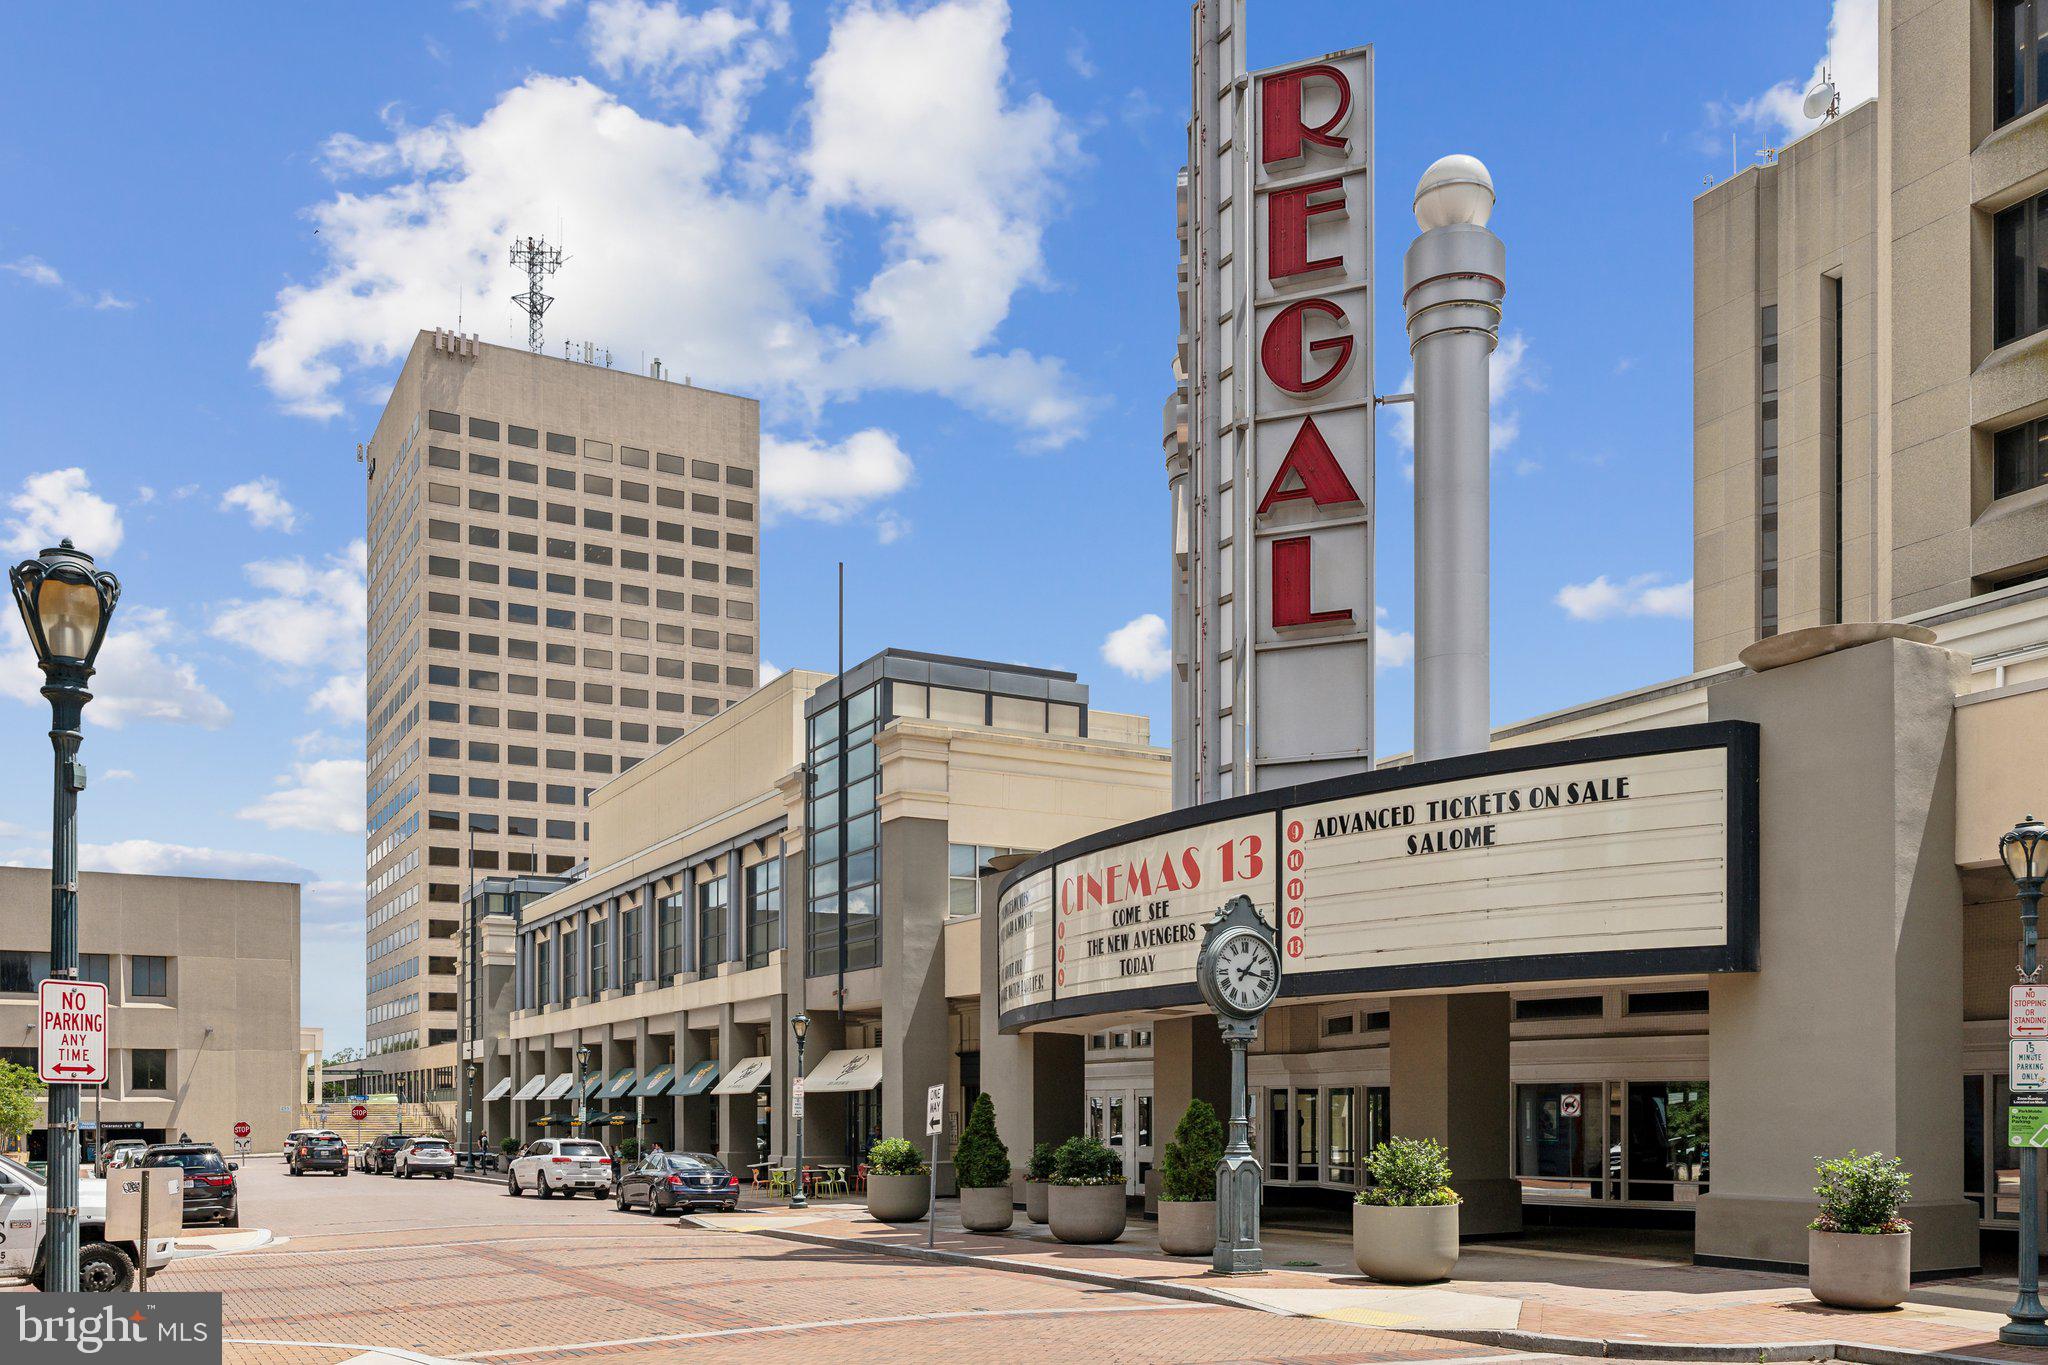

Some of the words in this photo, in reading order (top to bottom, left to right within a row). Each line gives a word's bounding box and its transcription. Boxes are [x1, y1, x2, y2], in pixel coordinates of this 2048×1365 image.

[1257, 64, 1363, 630] REGAL
[1313, 804, 1415, 839] ADVANCED
[1426, 789, 1521, 822] TICKETS
[1529, 784, 1559, 809] ON
[1567, 776, 1630, 805] SALE
[1406, 824, 1496, 855] SALOME
[1288, 850, 1302, 870] 10
[1061, 846, 1201, 916] CINEMAS
[1216, 835, 1264, 883] 13
[1288, 879, 1302, 899] 11
[1112, 905, 1142, 927] COME
[1148, 900, 1170, 920] SEE
[1288, 908, 1302, 927] 12
[1086, 938, 1104, 957] THE
[1107, 933, 1130, 953] NEW
[1133, 922, 1196, 949] AVENGERS
[1288, 937, 1302, 956] 13
[1119, 954, 1156, 976] TODAY
[62, 991, 87, 1011] NO
[2014, 999, 2047, 1007] STOPPING
[45, 1011, 102, 1032] PARKING
[2013, 1016, 2047, 1024] STANDING
[2025, 1008, 2035, 1016] OR
[61, 1033, 87, 1046] ANY
[2025, 1044, 2035, 1053] 15
[58, 1048, 90, 1062] TIME
[2018, 1053, 2042, 1061] MINUTE
[2016, 1063, 2044, 1071] PARKING
[2021, 1072, 2039, 1080] ONLY
[930, 1088, 941, 1101] ONE
[352, 1108, 367, 1116] STOP
[929, 1101, 941, 1114] WAY
